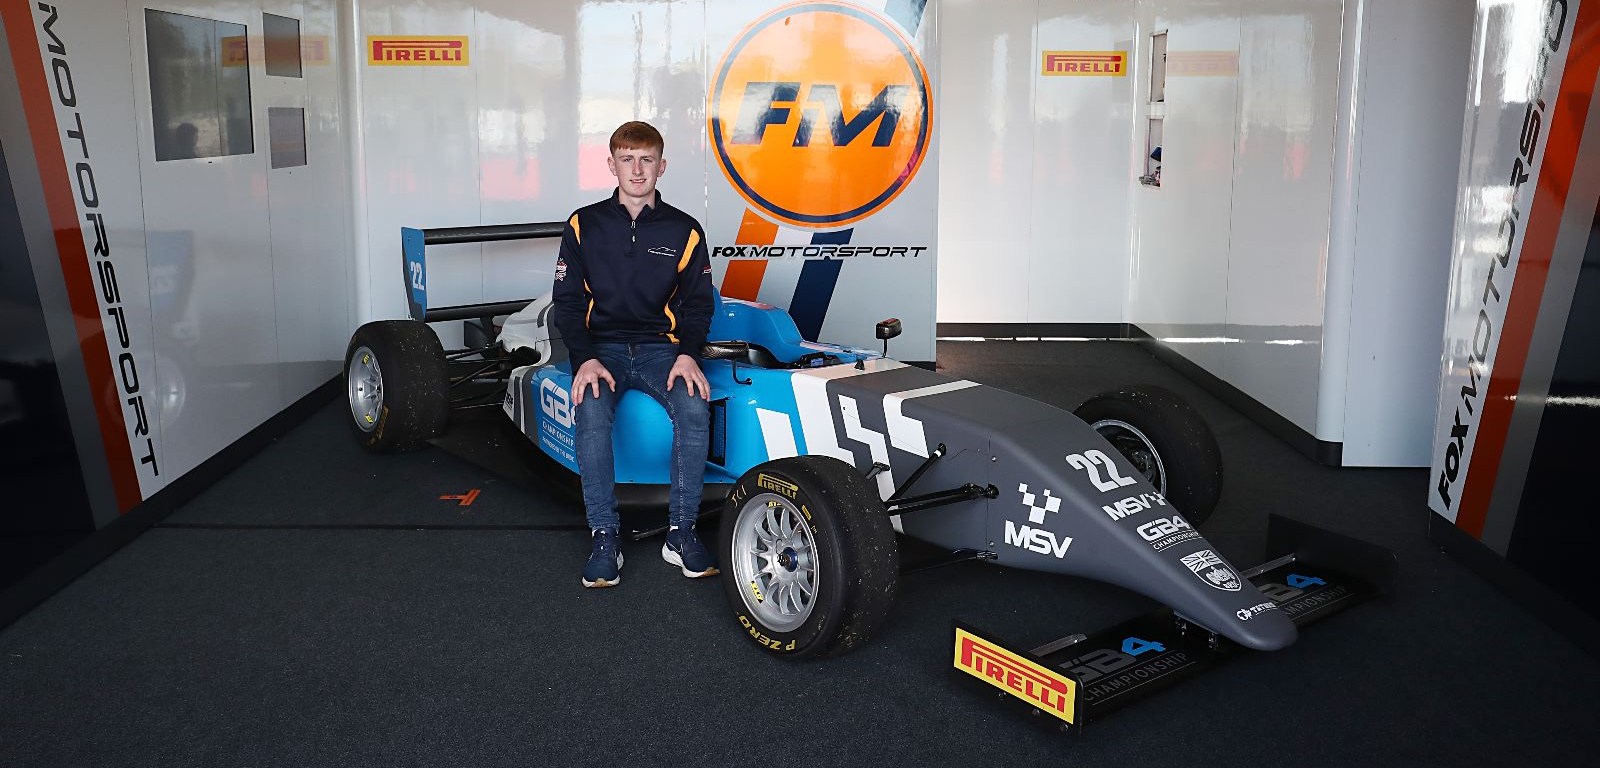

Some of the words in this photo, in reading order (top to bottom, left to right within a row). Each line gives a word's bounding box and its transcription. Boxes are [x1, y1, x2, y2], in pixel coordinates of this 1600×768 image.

[372, 40, 462, 61] PIRELLI
[1046, 54, 1122, 73] PIRELLI
[730, 81, 912, 147] FM
[38, 2, 158, 476] MOTORSPORT
[711, 246, 747, 258] FOX
[749, 246, 927, 258] MOTORSPORT
[409, 260, 425, 291] 22
[540, 377, 577, 429] GB
[1065, 449, 1138, 493] 22
[1438, 405, 1469, 511] FOX
[757, 473, 799, 500] PIRELLI
[1101, 493, 1152, 521] MSV
[1004, 520, 1074, 559] MSV
[1136, 515, 1191, 542] GB4
[1153, 530, 1200, 550] CHAMPIONSHIP
[1256, 573, 1327, 602] B4
[739, 615, 782, 650] ZERO
[785, 639, 796, 651] P
[960, 636, 1068, 714] PIRELLI
